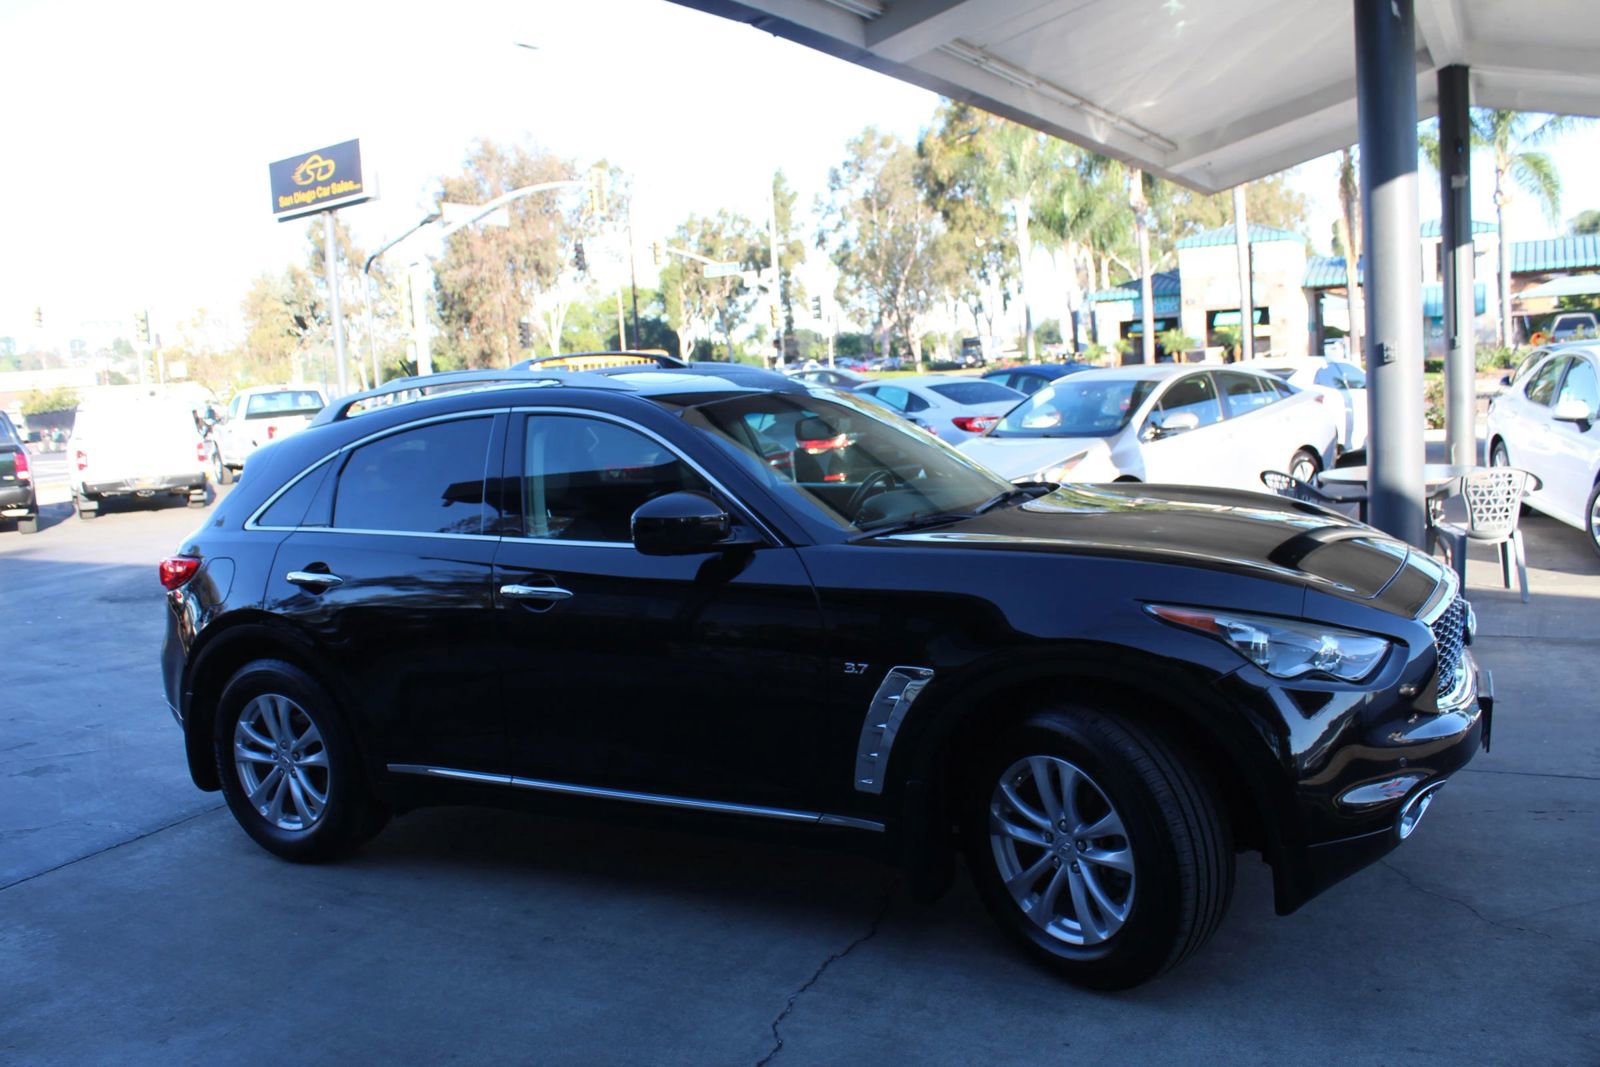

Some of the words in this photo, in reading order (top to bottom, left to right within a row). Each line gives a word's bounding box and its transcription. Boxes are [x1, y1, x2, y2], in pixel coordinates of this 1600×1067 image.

[293, 189, 316, 203] Diego
[316, 185, 330, 198] Car
[844, 662, 869, 674] 3.7
